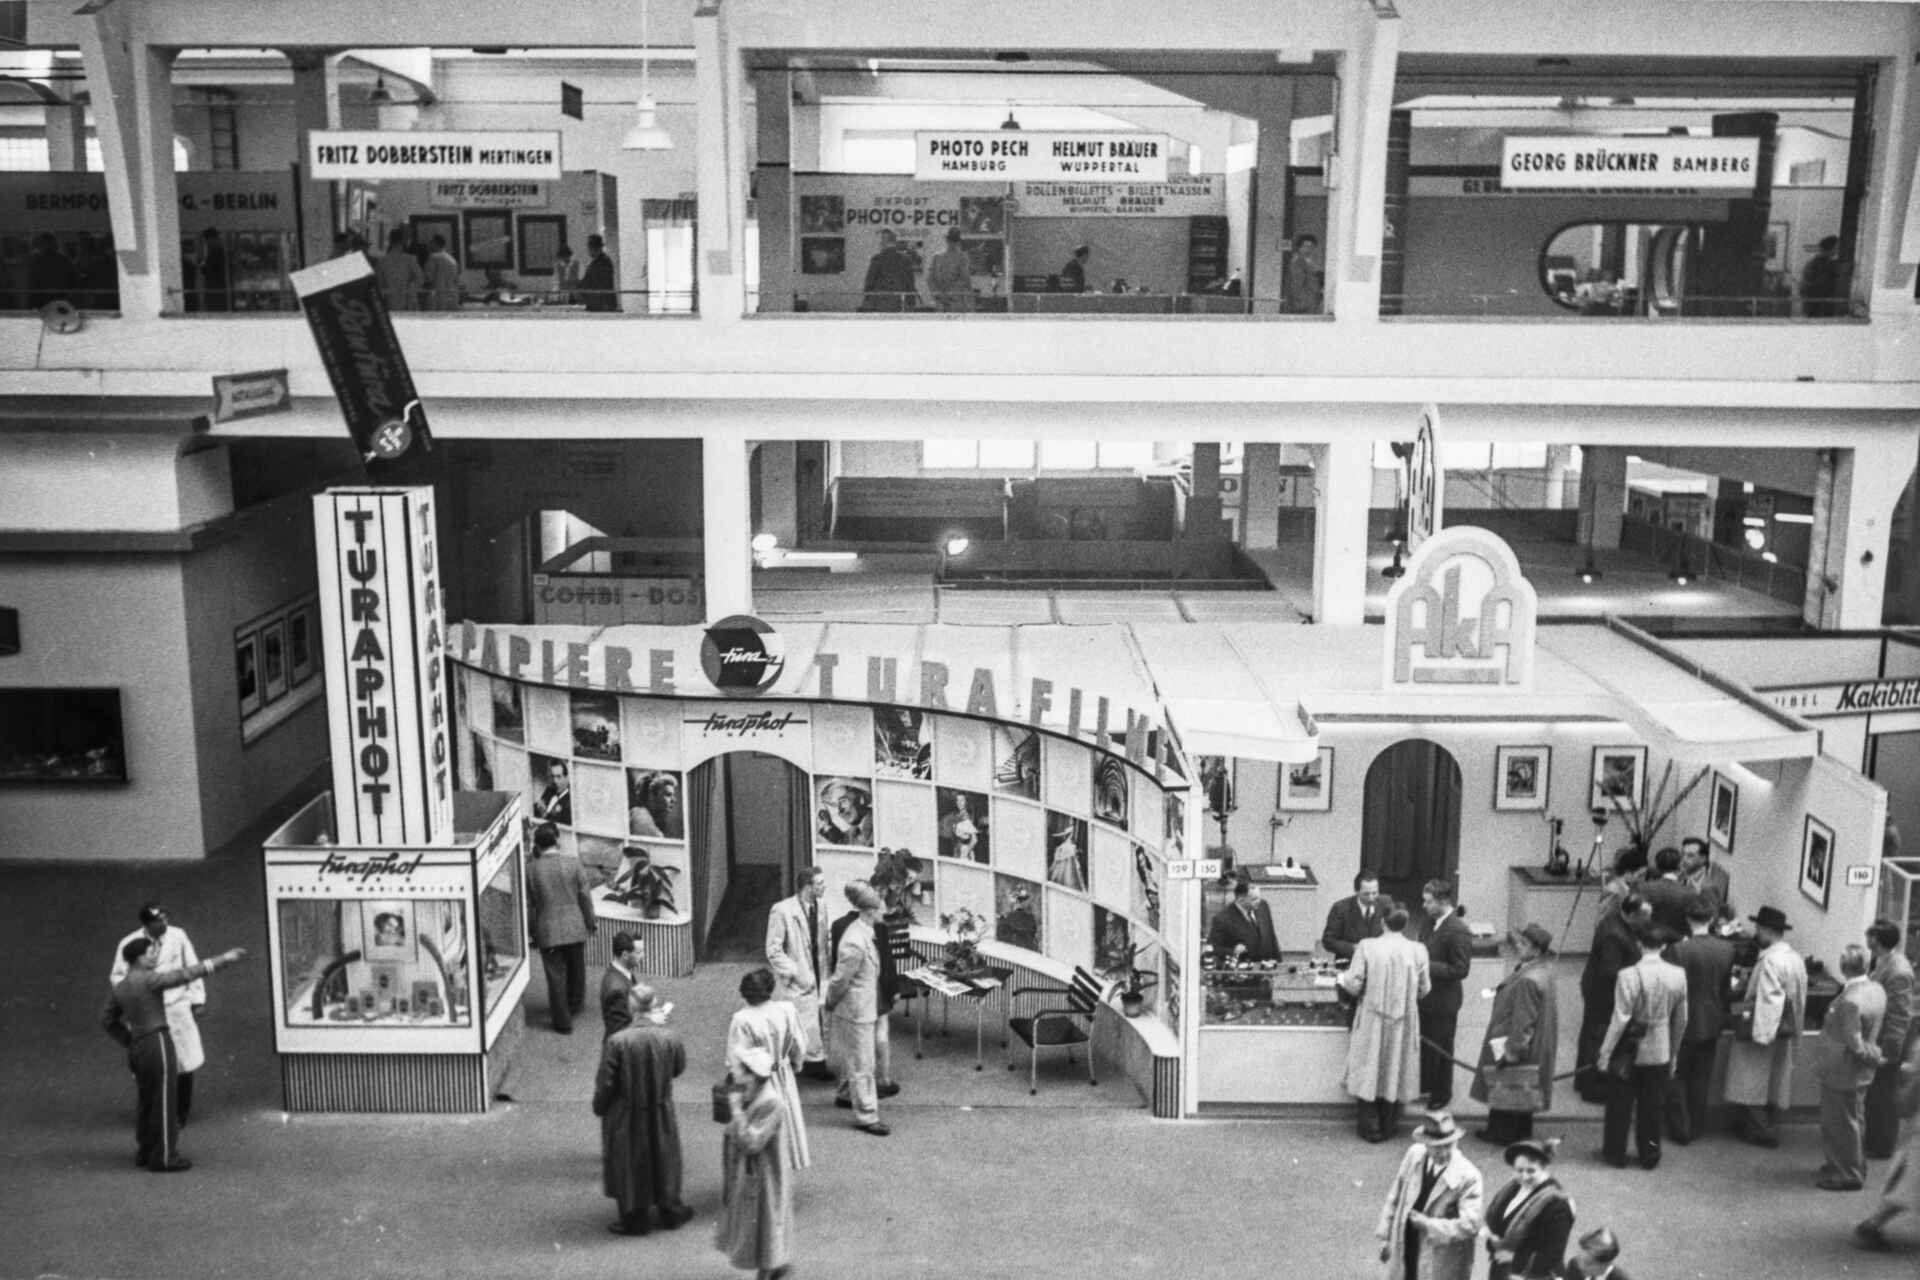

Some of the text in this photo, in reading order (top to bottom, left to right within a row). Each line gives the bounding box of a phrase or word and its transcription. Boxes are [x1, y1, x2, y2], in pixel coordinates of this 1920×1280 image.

[317, 145, 553, 165] FRITZ DOBBERSTEIN MERTINGEN
[930, 139, 1029, 156] PHOTO PECH
[1052, 141, 1104, 157] HELMUT
[942, 159, 1007, 171] HAMBURG
[1060, 161, 1140, 173] WUPPERTAL
[1511, 148, 1750, 172] GEORG BRÜCKNER BAMBERG
[25, 191, 109, 210] BERMPO
[847, 208, 959, 225] PHOTO-PECH
[417, 503, 447, 801] TURAPHOT
[461, 619, 675, 695] PAPIERE
[344, 510, 390, 816] TURAPHOT
